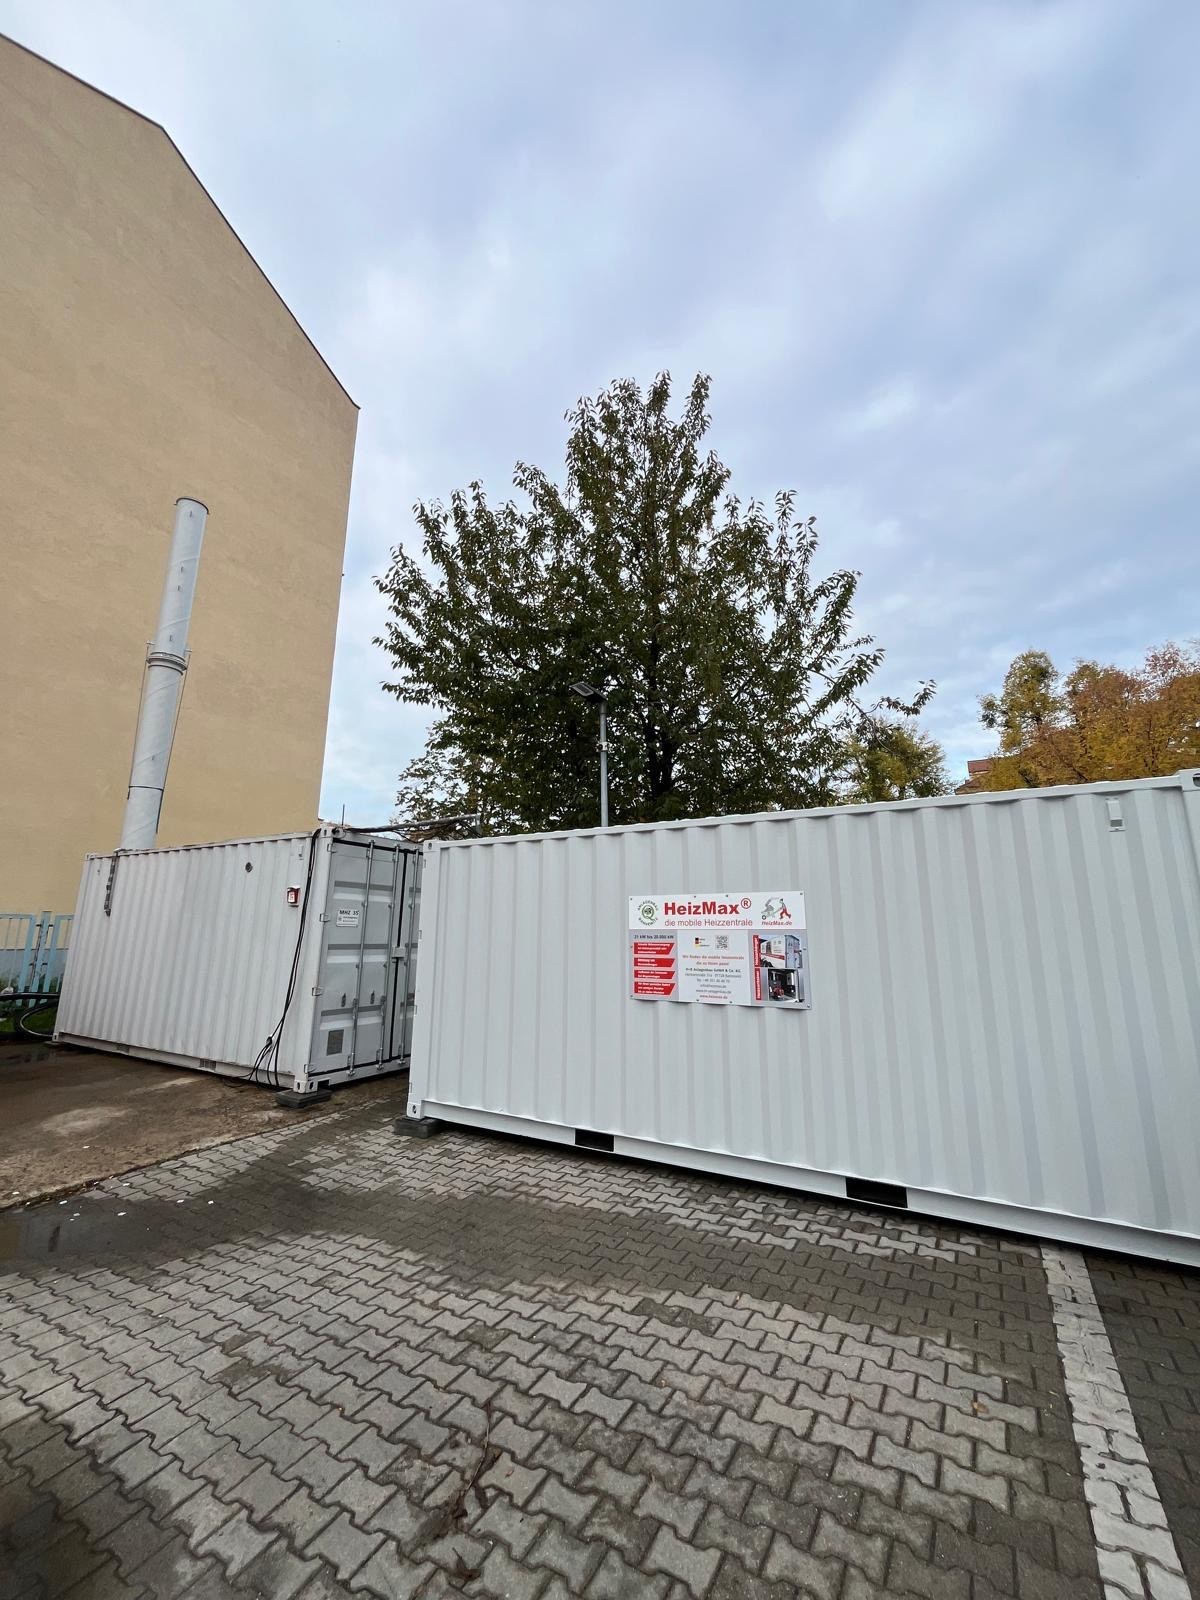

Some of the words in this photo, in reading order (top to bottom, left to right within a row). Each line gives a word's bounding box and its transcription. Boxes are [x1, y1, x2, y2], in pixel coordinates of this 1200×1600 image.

[664, 919, 676, 927] die
[677, 919, 702, 927] mobile
[704, 918, 753, 927] Heizzentrale
